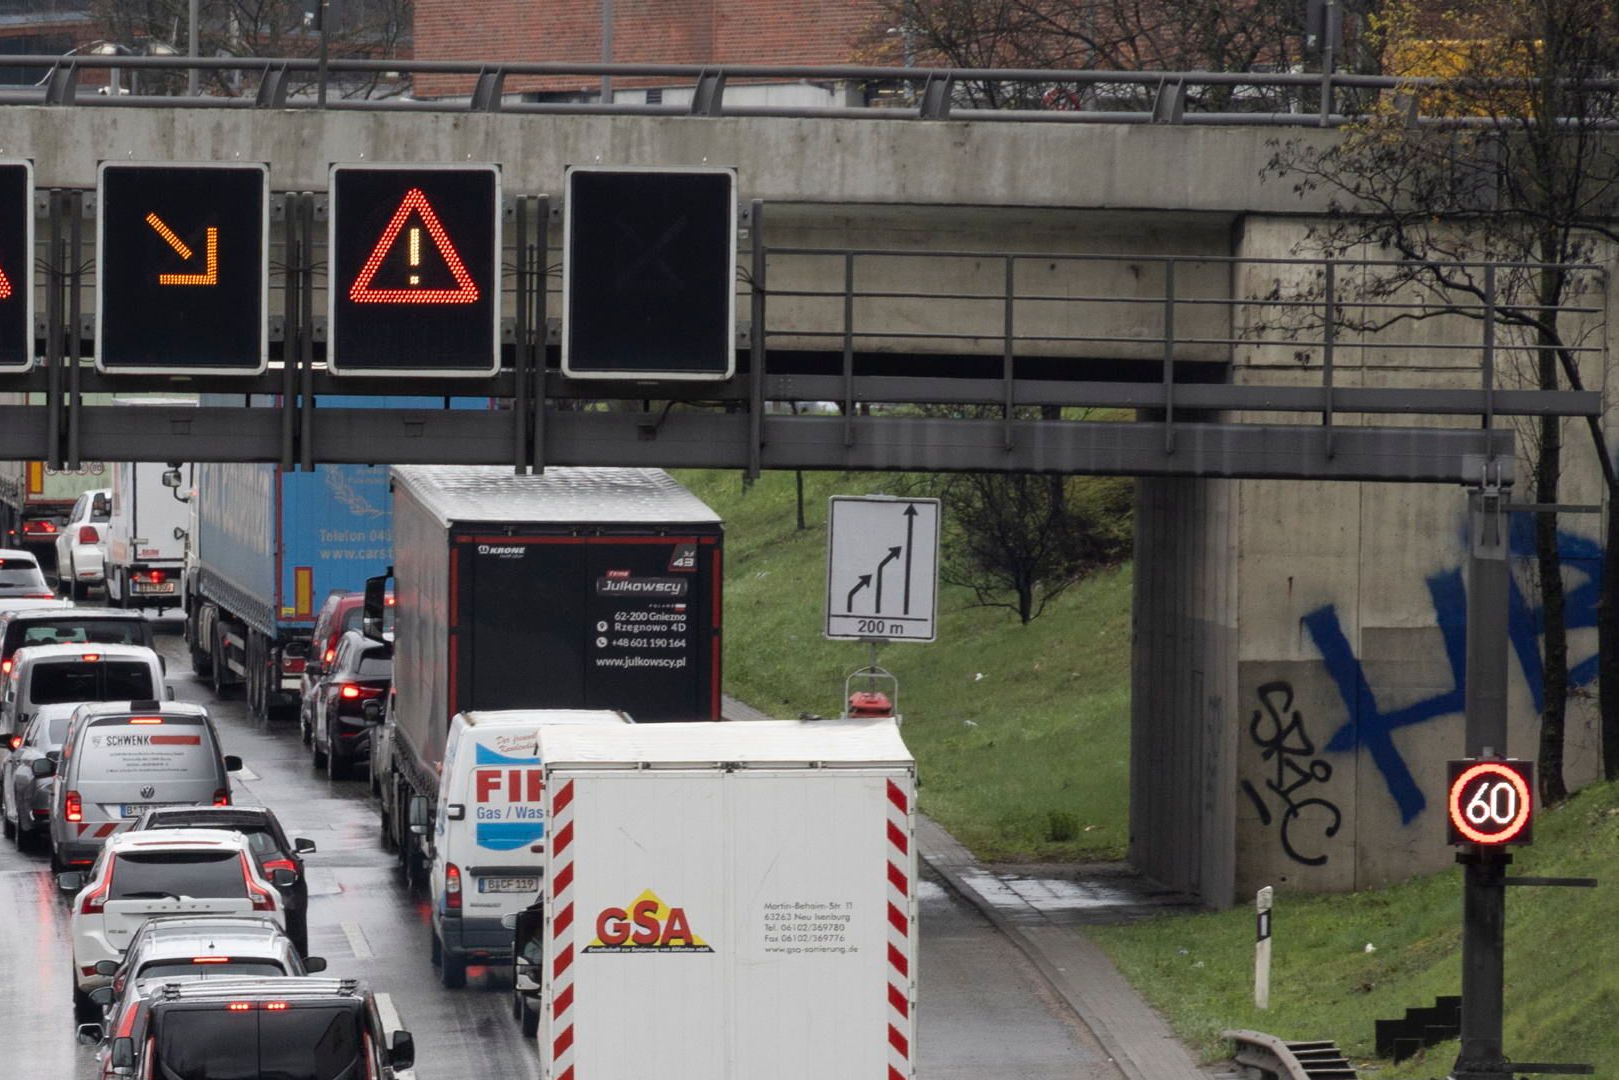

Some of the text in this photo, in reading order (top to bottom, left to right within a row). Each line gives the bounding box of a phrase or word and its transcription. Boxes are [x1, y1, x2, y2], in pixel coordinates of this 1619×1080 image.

[320, 529, 365, 541] Telefon
[673, 558, 694, 567] 43
[602, 581, 681, 595] Julkowscy
[614, 612, 686, 621] 62-200 Gniezno
[614, 622, 686, 633] Rzegnowo 4D
[858, 619, 904, 634] 200 m
[612, 638, 686, 647] +48 601 190 164
[596, 656, 686, 668] www.julkowscy.pl
[107, 735, 149, 746] SCHWENK
[1465, 782, 1515, 824] 60
[477, 806, 501, 819] Gas
[488, 880, 534, 890] B CF 119
[596, 900, 695, 946] GSA
[764, 913, 851, 923] 63263 Neu Isenburg
[764, 944, 859, 955] www.gsa-sanierung.de
